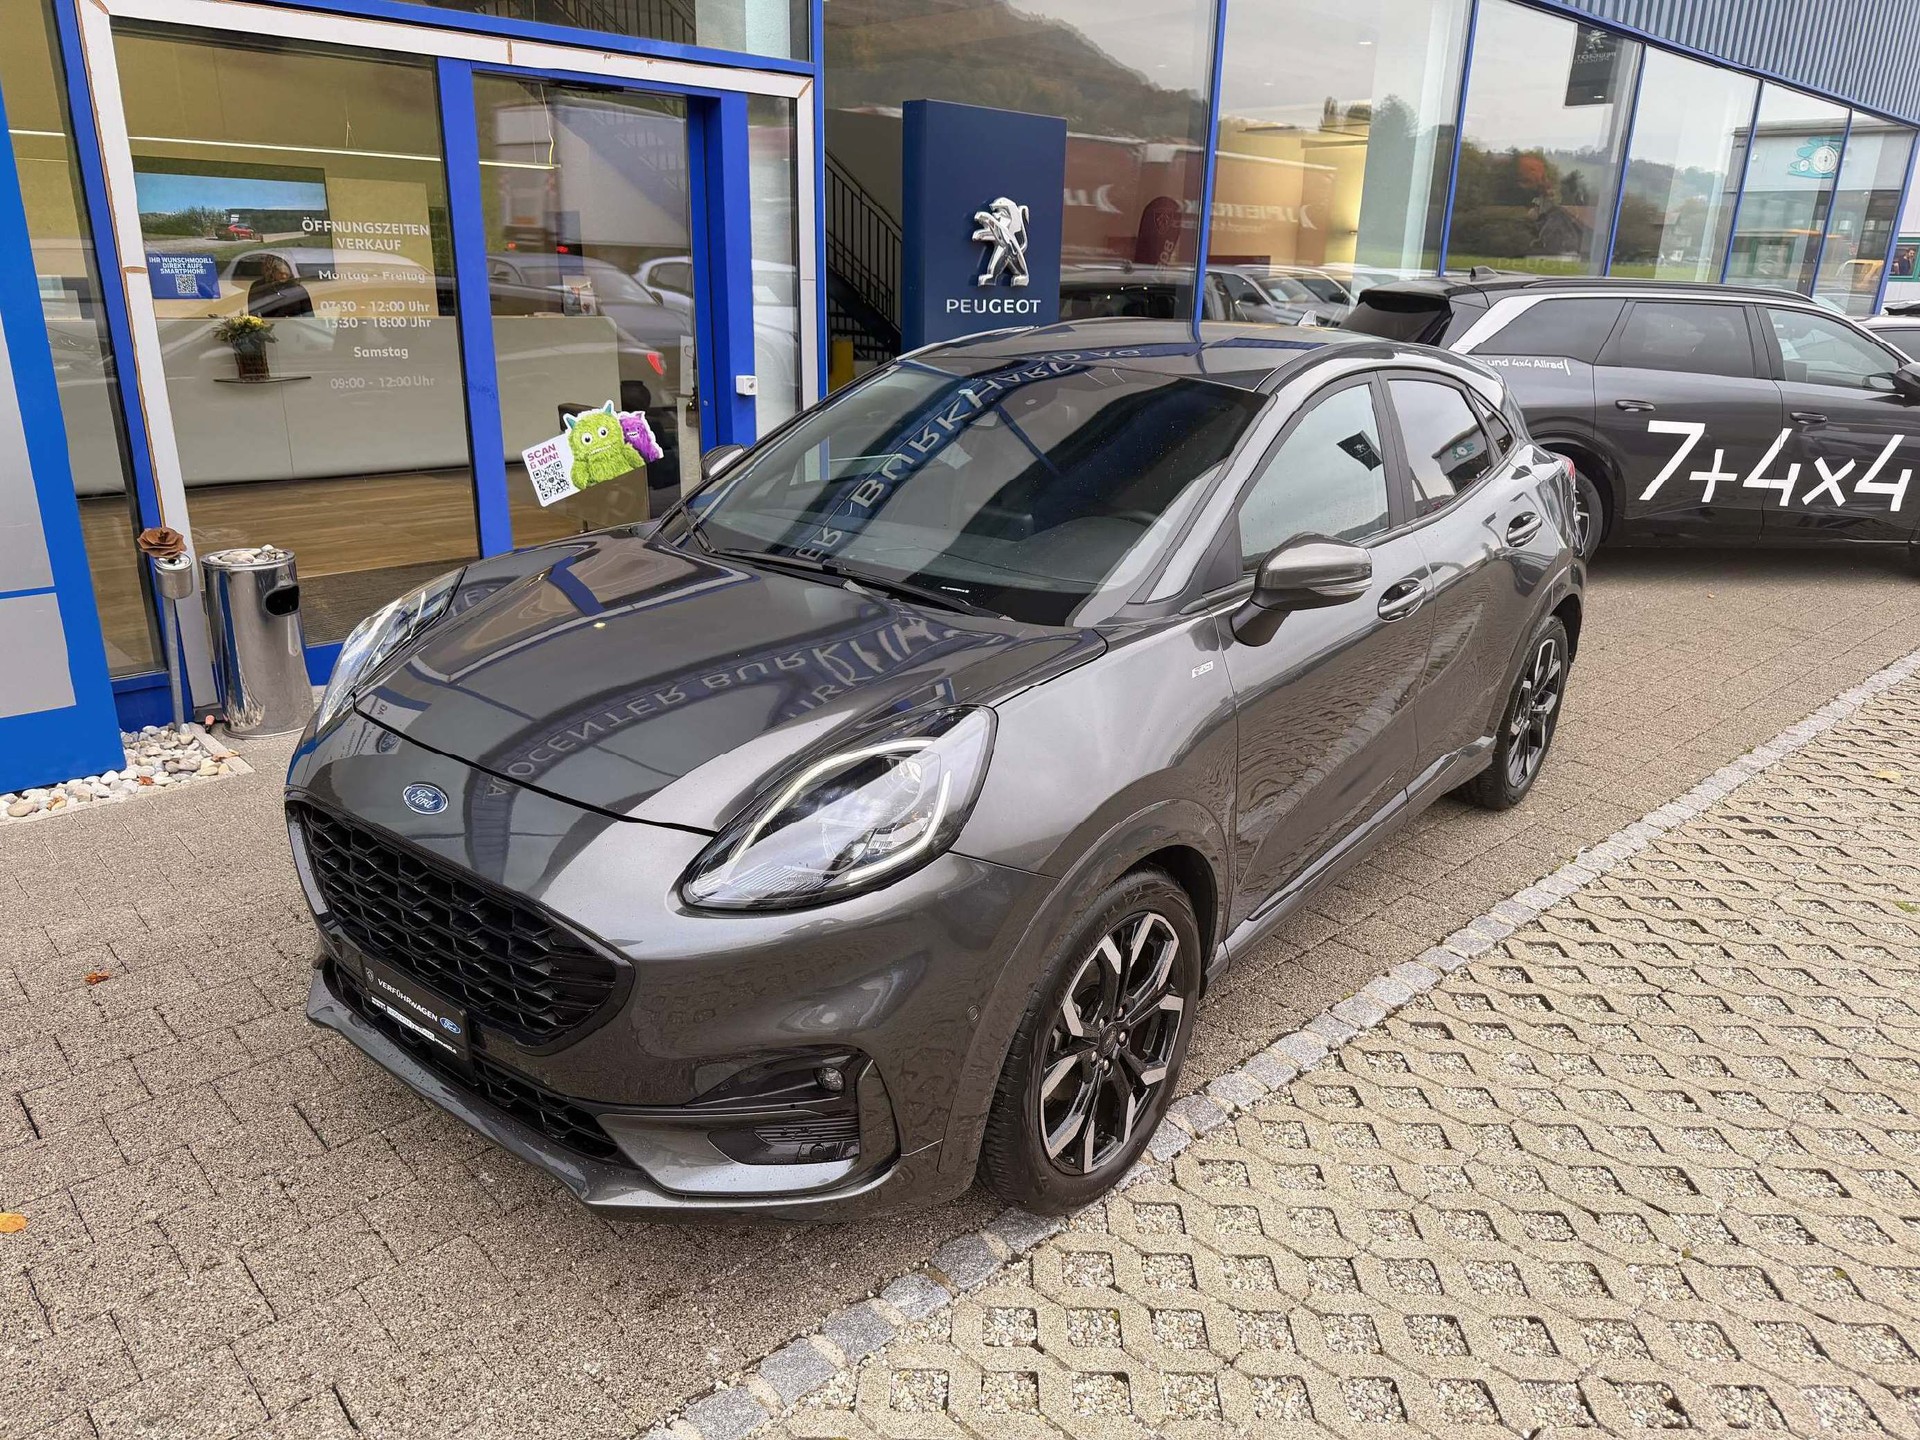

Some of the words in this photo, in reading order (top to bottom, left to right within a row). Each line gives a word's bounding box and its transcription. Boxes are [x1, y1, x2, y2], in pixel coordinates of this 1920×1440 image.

[301, 216, 429, 236] ÖFFNUNGSZEITEN
[337, 238, 401, 251] VERKAUF
[318, 270, 369, 283] Montag
[382, 271, 426, 284] Freitag
[320, 301, 357, 313] 07:30
[370, 301, 405, 313] 12:00
[409, 301, 431, 313] Uhr
[946, 299, 1041, 314] PEUGEOT
[324, 317, 359, 328] 13:30
[373, 316, 407, 328] 18:00
[410, 316, 432, 328] Uhr
[353, 346, 409, 359] Samstag
[1487, 358, 1509, 367] und
[1512, 358, 1532, 368] 4x4
[1534, 358, 1565, 370] Allrad
[330, 377, 366, 390] 09:00
[379, 376, 412, 388] 12:00
[413, 375, 436, 387] Uhr
[527, 443, 556, 462] SCAN
[537, 451, 560, 466] WIN!
[1639, 419, 1914, 512] 7+4x4
